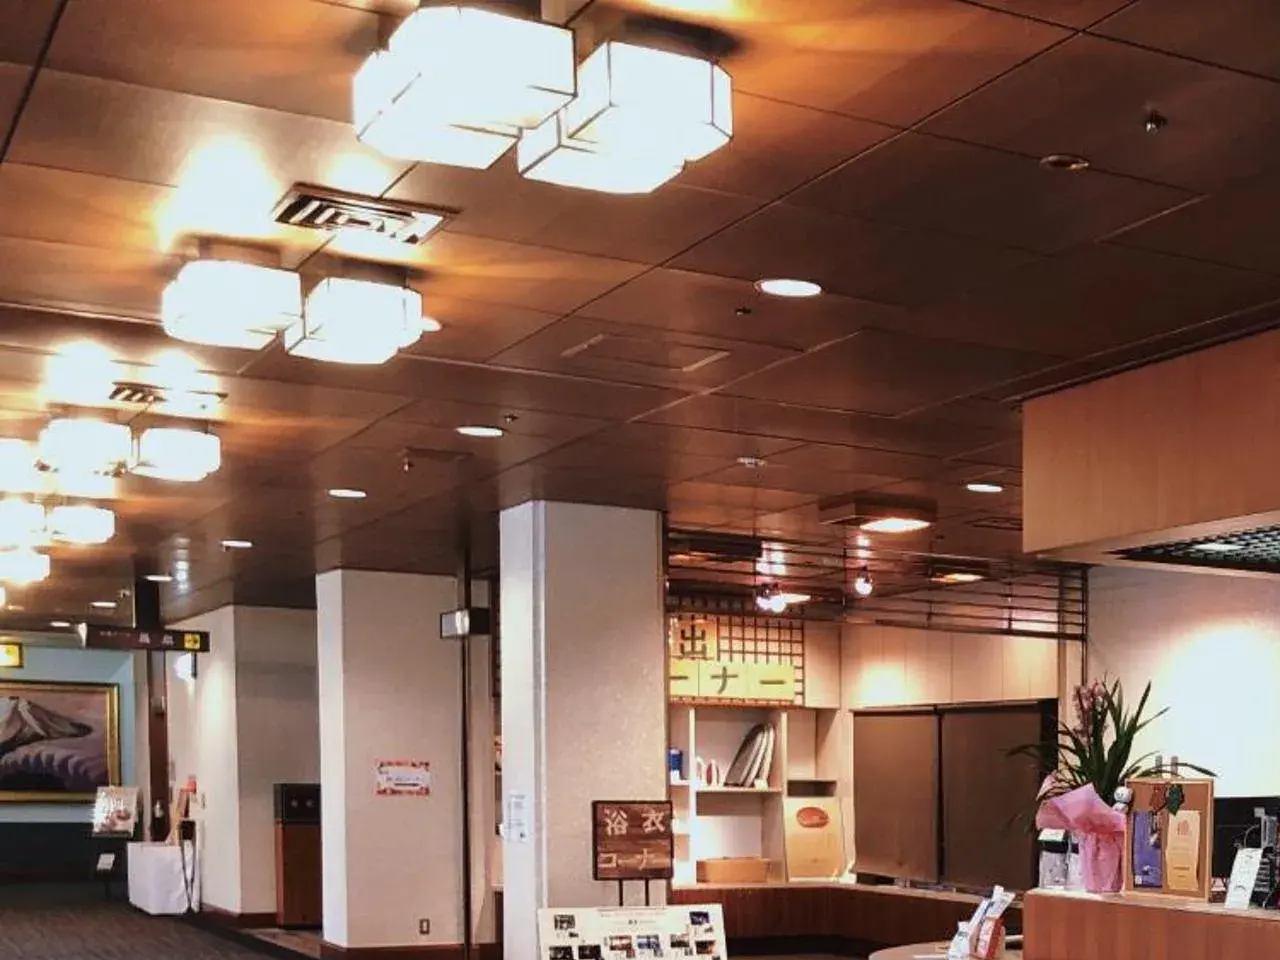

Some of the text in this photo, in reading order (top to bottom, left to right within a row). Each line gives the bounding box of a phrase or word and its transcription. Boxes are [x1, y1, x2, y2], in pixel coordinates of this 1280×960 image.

[603, 808, 667, 836] 浴衣
[598, 848, 671, 871] コーナー
